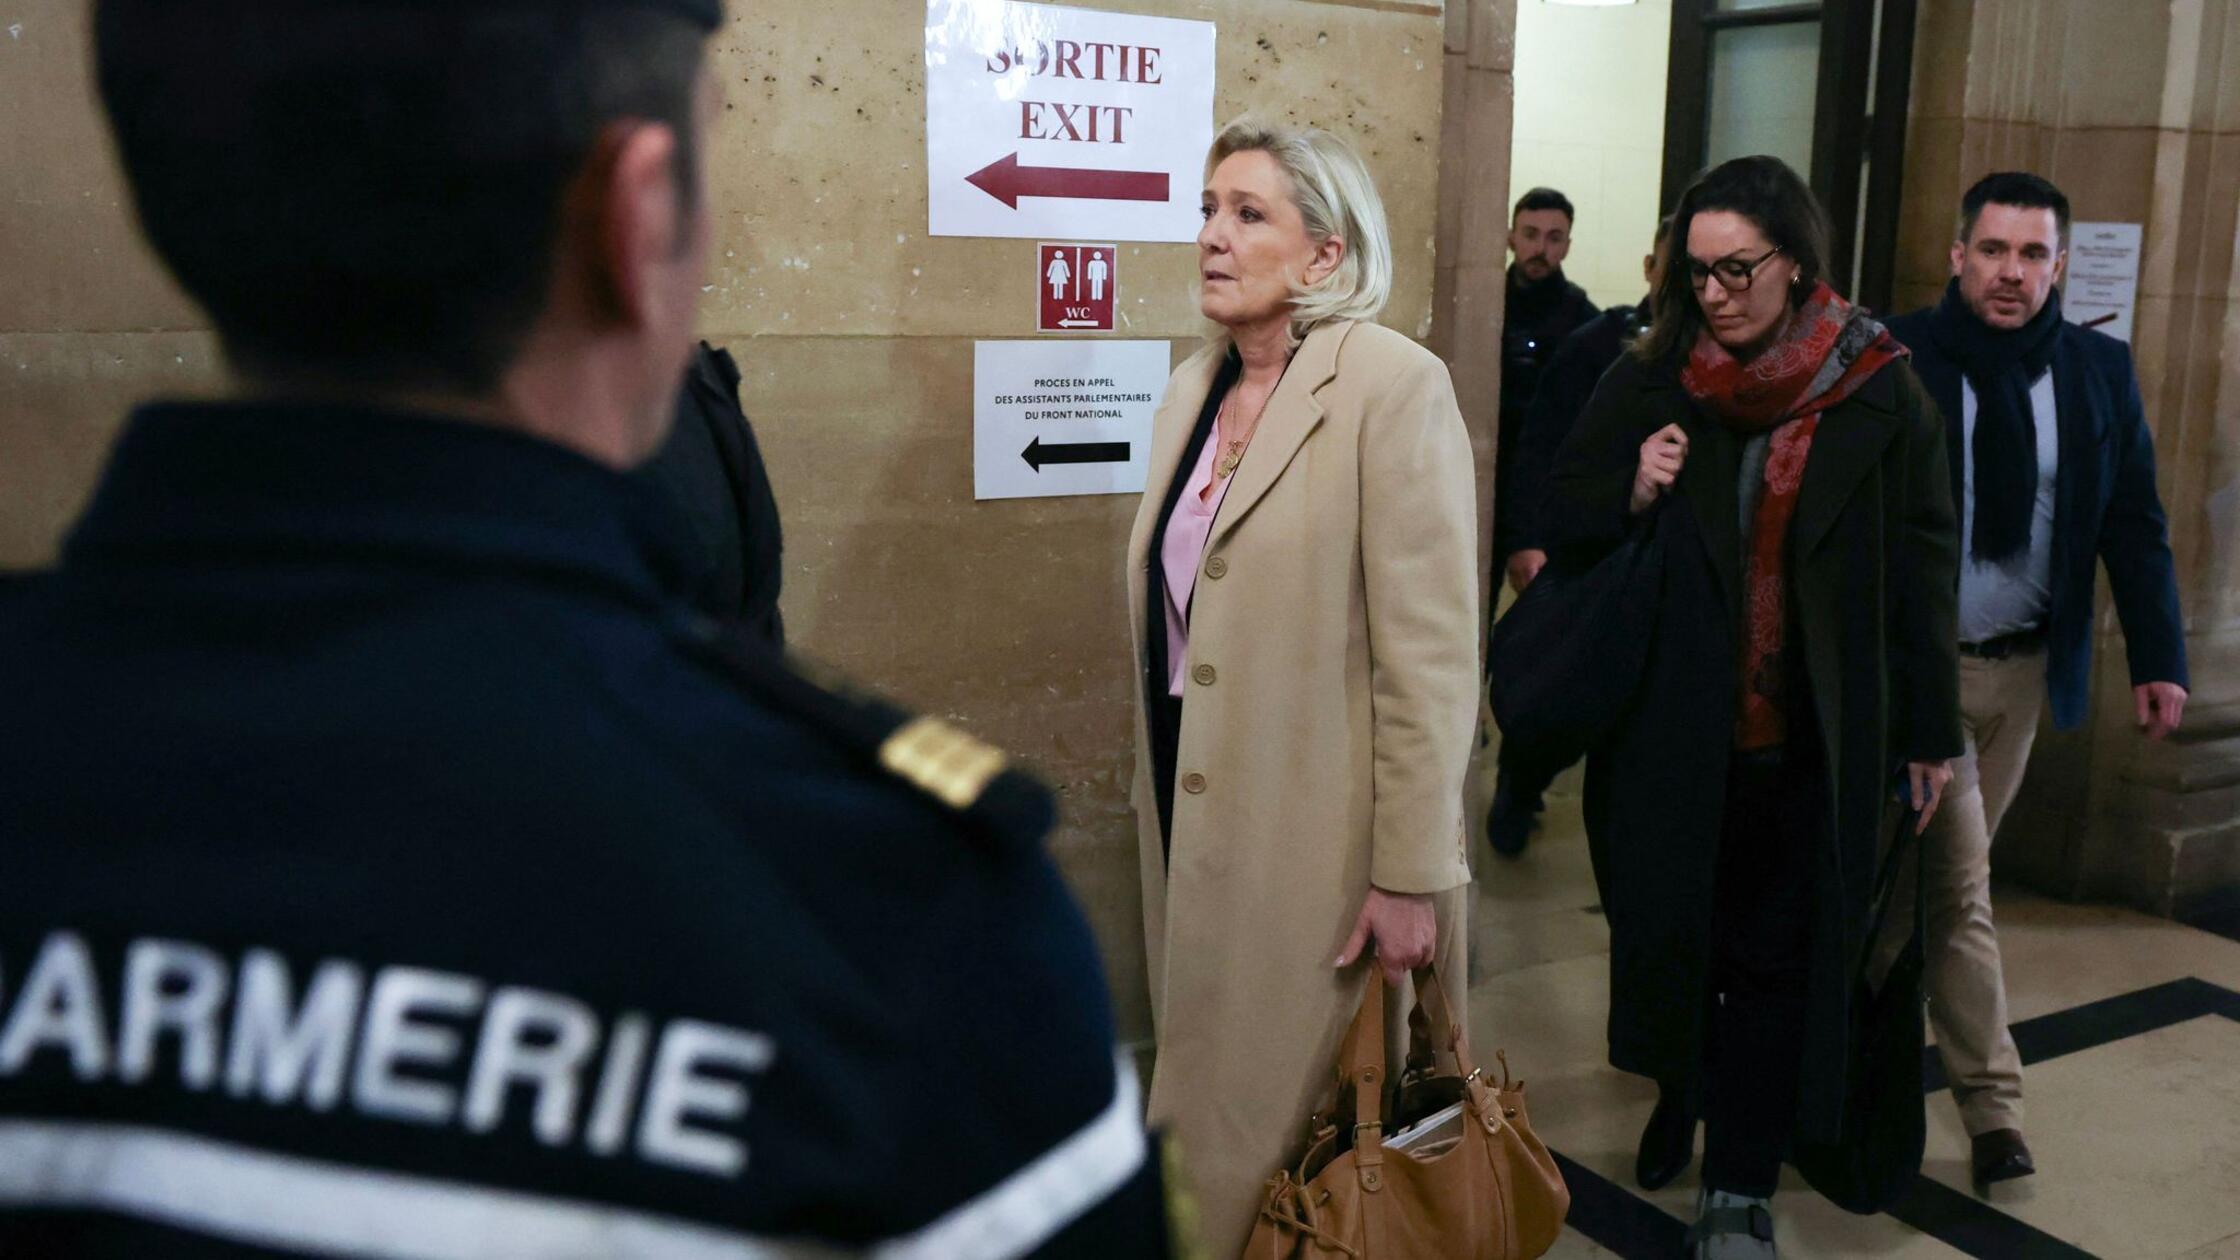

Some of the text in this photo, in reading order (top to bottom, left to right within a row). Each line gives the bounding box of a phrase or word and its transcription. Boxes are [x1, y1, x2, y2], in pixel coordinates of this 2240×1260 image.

[1017, 100, 1133, 144] EXIT
[1065, 306, 1091, 319] WC
[1034, 378, 1115, 388] PROCES EN APPEL
[995, 393, 1152, 404] DES ASSISTANTS PARLEMENTAIRES
[1025, 409, 1123, 420] DU FRONT NATIONAL
[0, 931, 773, 1178] ARMERIE
